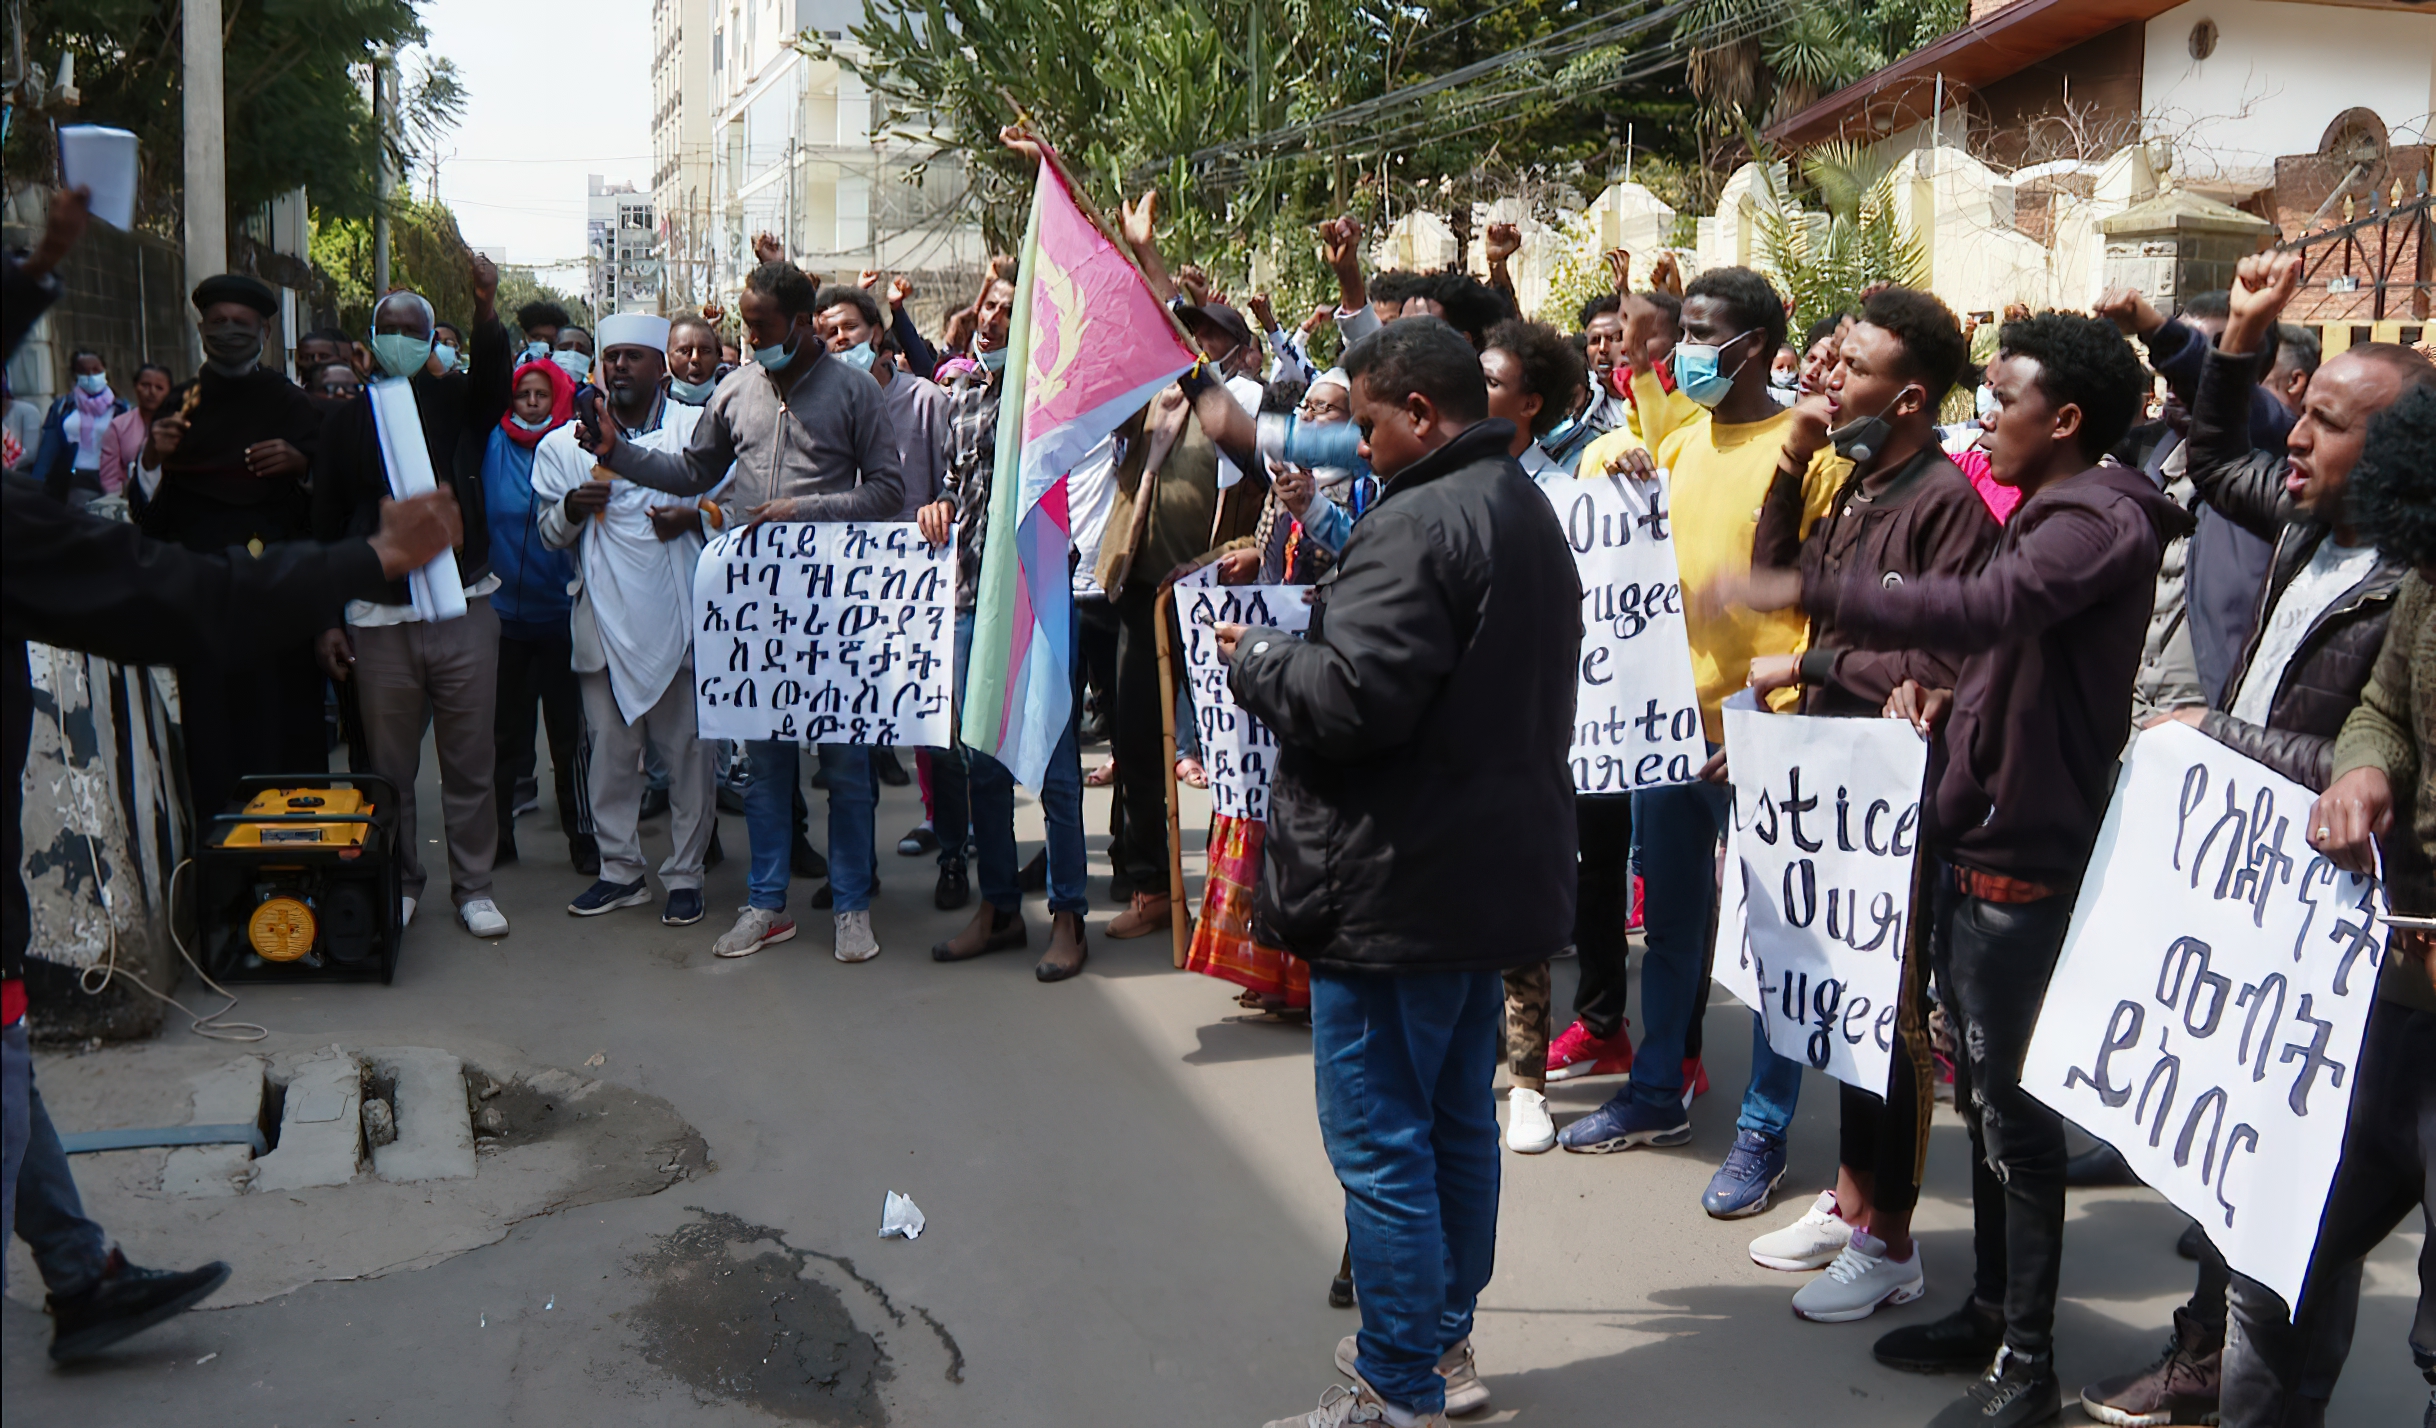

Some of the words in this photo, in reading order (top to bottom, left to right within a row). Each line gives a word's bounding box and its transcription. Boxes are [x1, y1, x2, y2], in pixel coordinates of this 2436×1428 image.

[1568, 489, 1669, 554] Out
[1583, 582, 1681, 639] ugee
[1570, 704, 1626, 747] nt
[1634, 698, 1697, 743] to
[1782, 858, 1903, 962] Our
